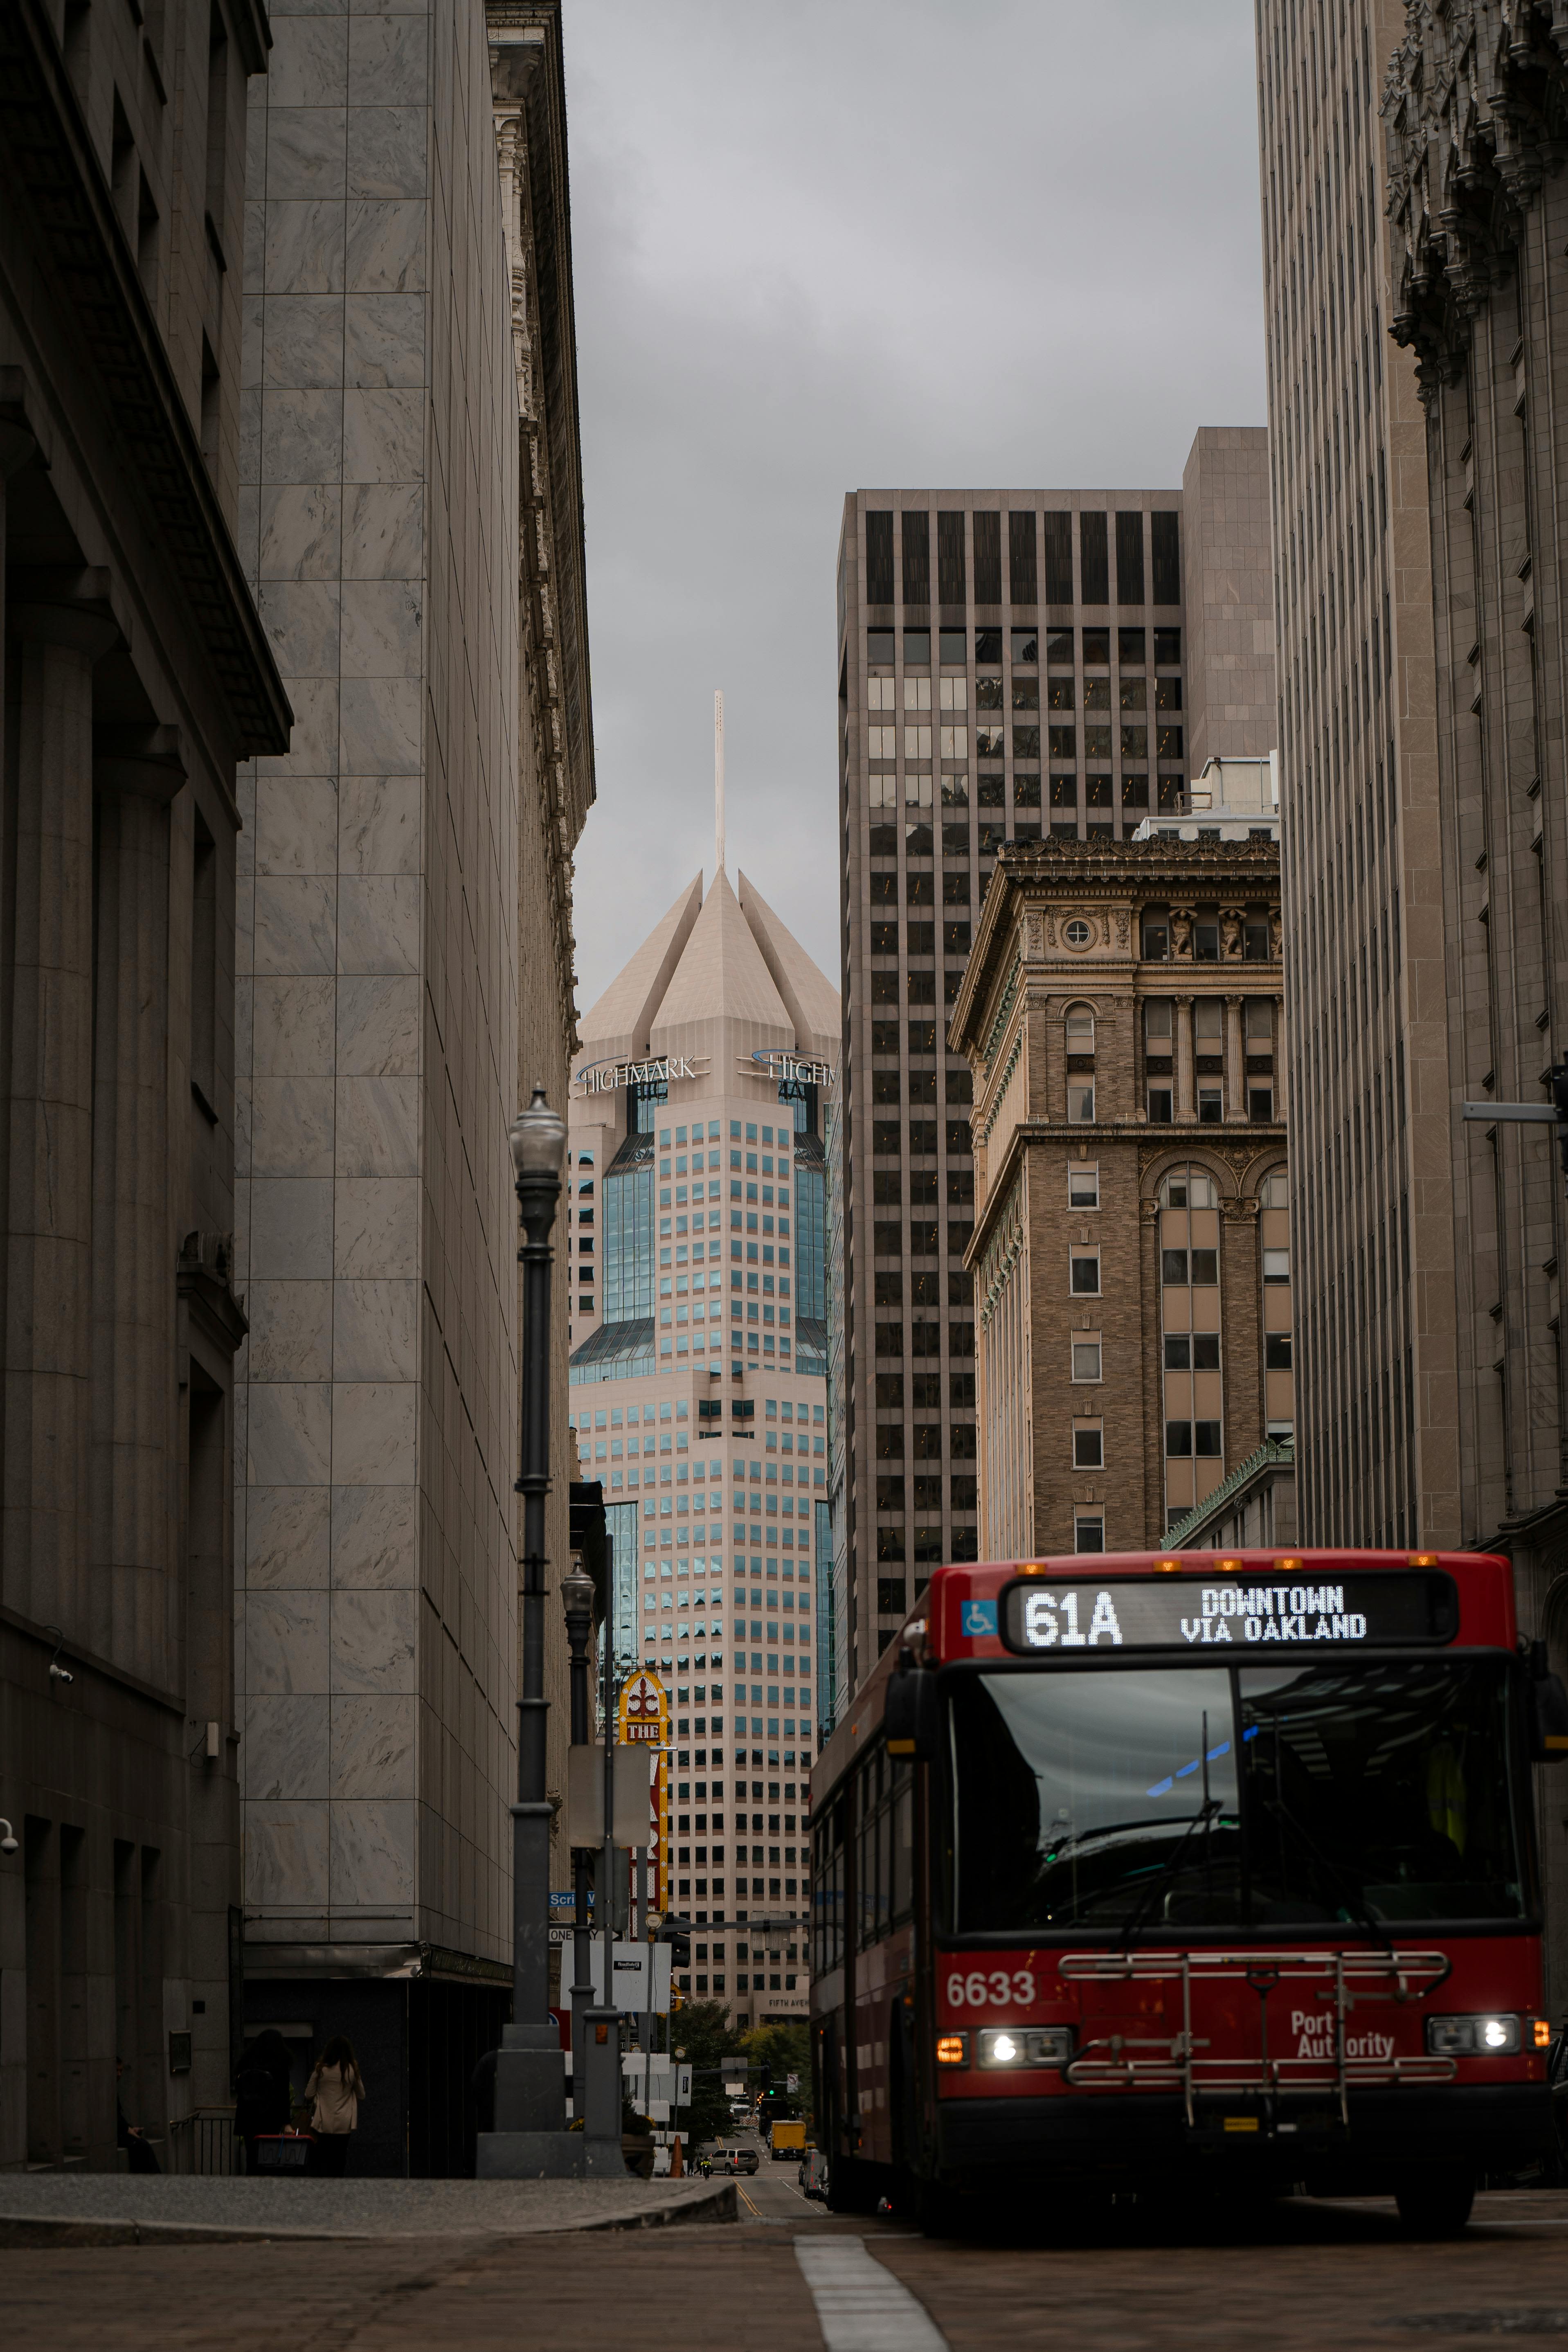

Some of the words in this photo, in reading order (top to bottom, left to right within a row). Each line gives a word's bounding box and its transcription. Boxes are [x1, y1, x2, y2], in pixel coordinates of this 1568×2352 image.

[584, 1055, 695, 1095] HIGHMARK
[1202, 1586, 1344, 1616] DOWNTOWN
[1026, 1591, 1123, 1646] 61A
[1181, 1618, 1233, 1642] VIA
[1245, 1614, 1367, 1641] OAKLAND
[628, 1725, 659, 1739] THE
[551, 1894, 575, 1905] Scri
[551, 1930, 572, 1940] ONE
[947, 1969, 1036, 2007] 6633
[1291, 2010, 1334, 2035] Port
[1297, 2031, 1395, 2059] Autority
